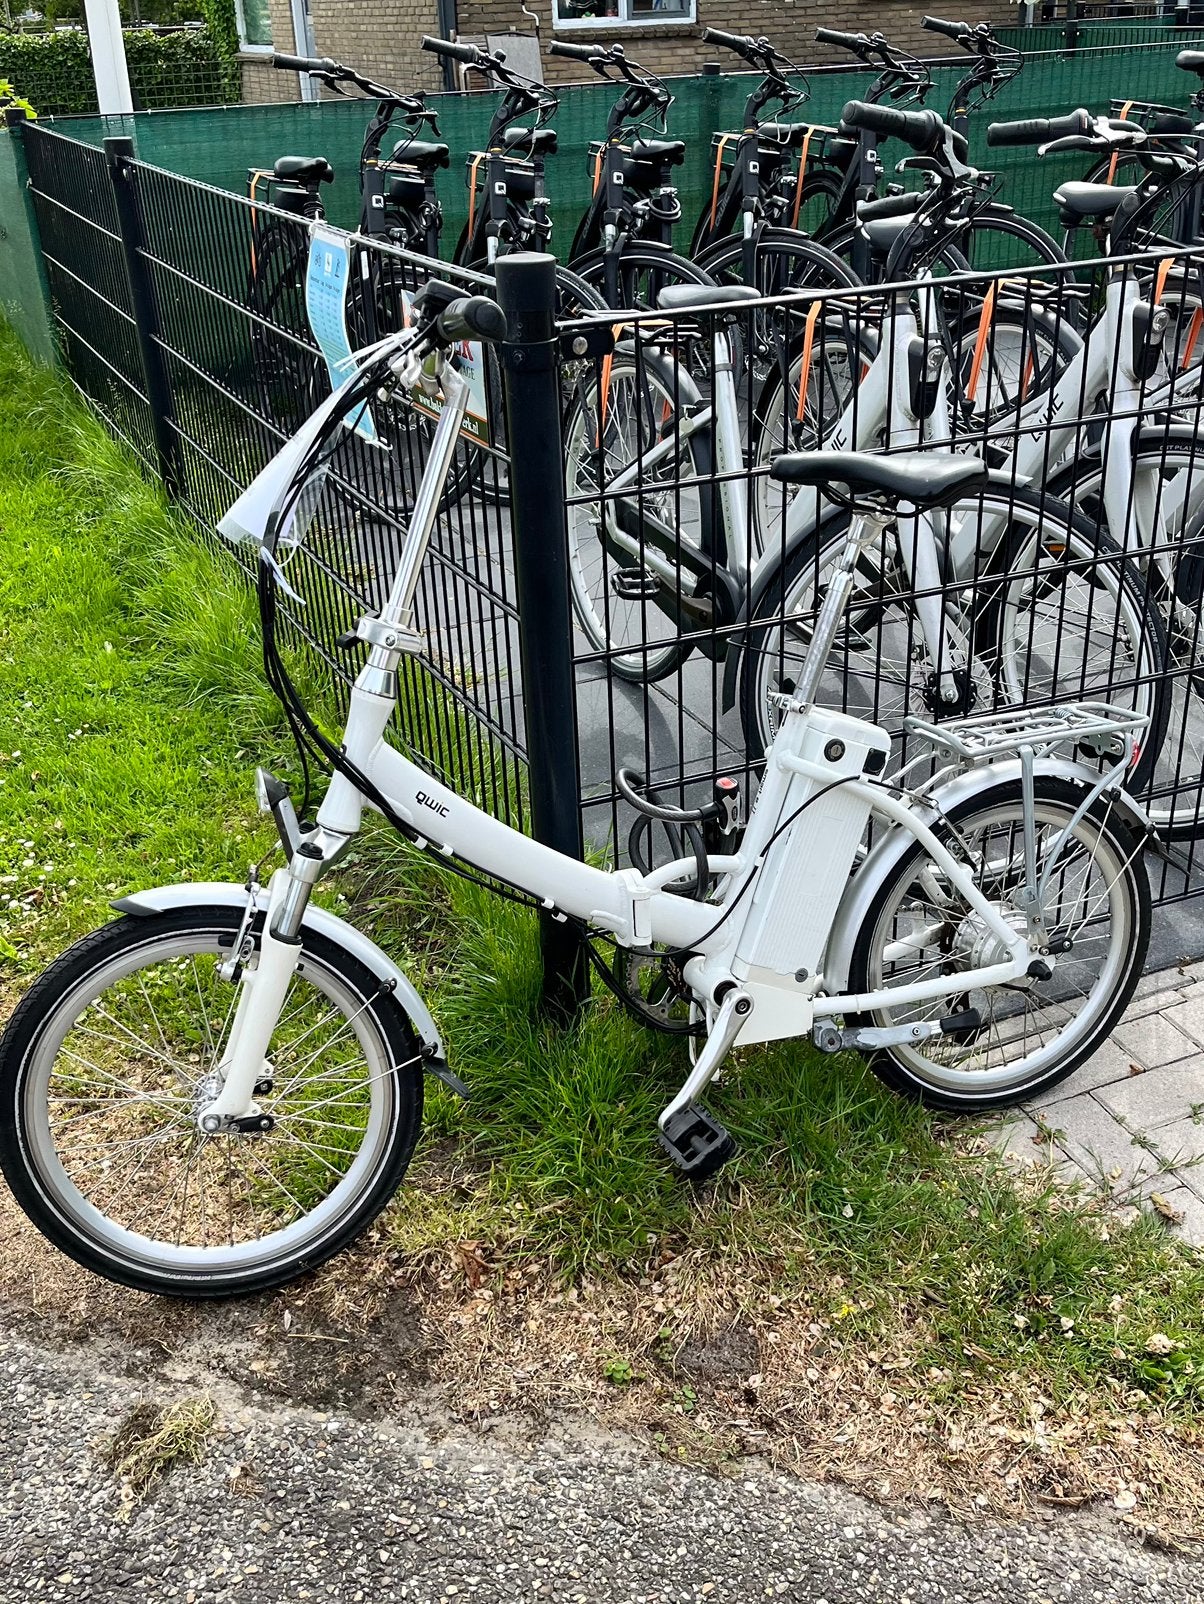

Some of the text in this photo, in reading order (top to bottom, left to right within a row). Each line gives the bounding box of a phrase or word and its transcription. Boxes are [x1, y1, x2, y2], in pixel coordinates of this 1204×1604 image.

[867, 149, 877, 163] Q
[749, 161, 759, 174] Q
[613, 171, 624, 184] Q
[494, 181, 507, 195] Q
[371, 194, 384, 208] Q
[415, 790, 450, 818] QWIC
